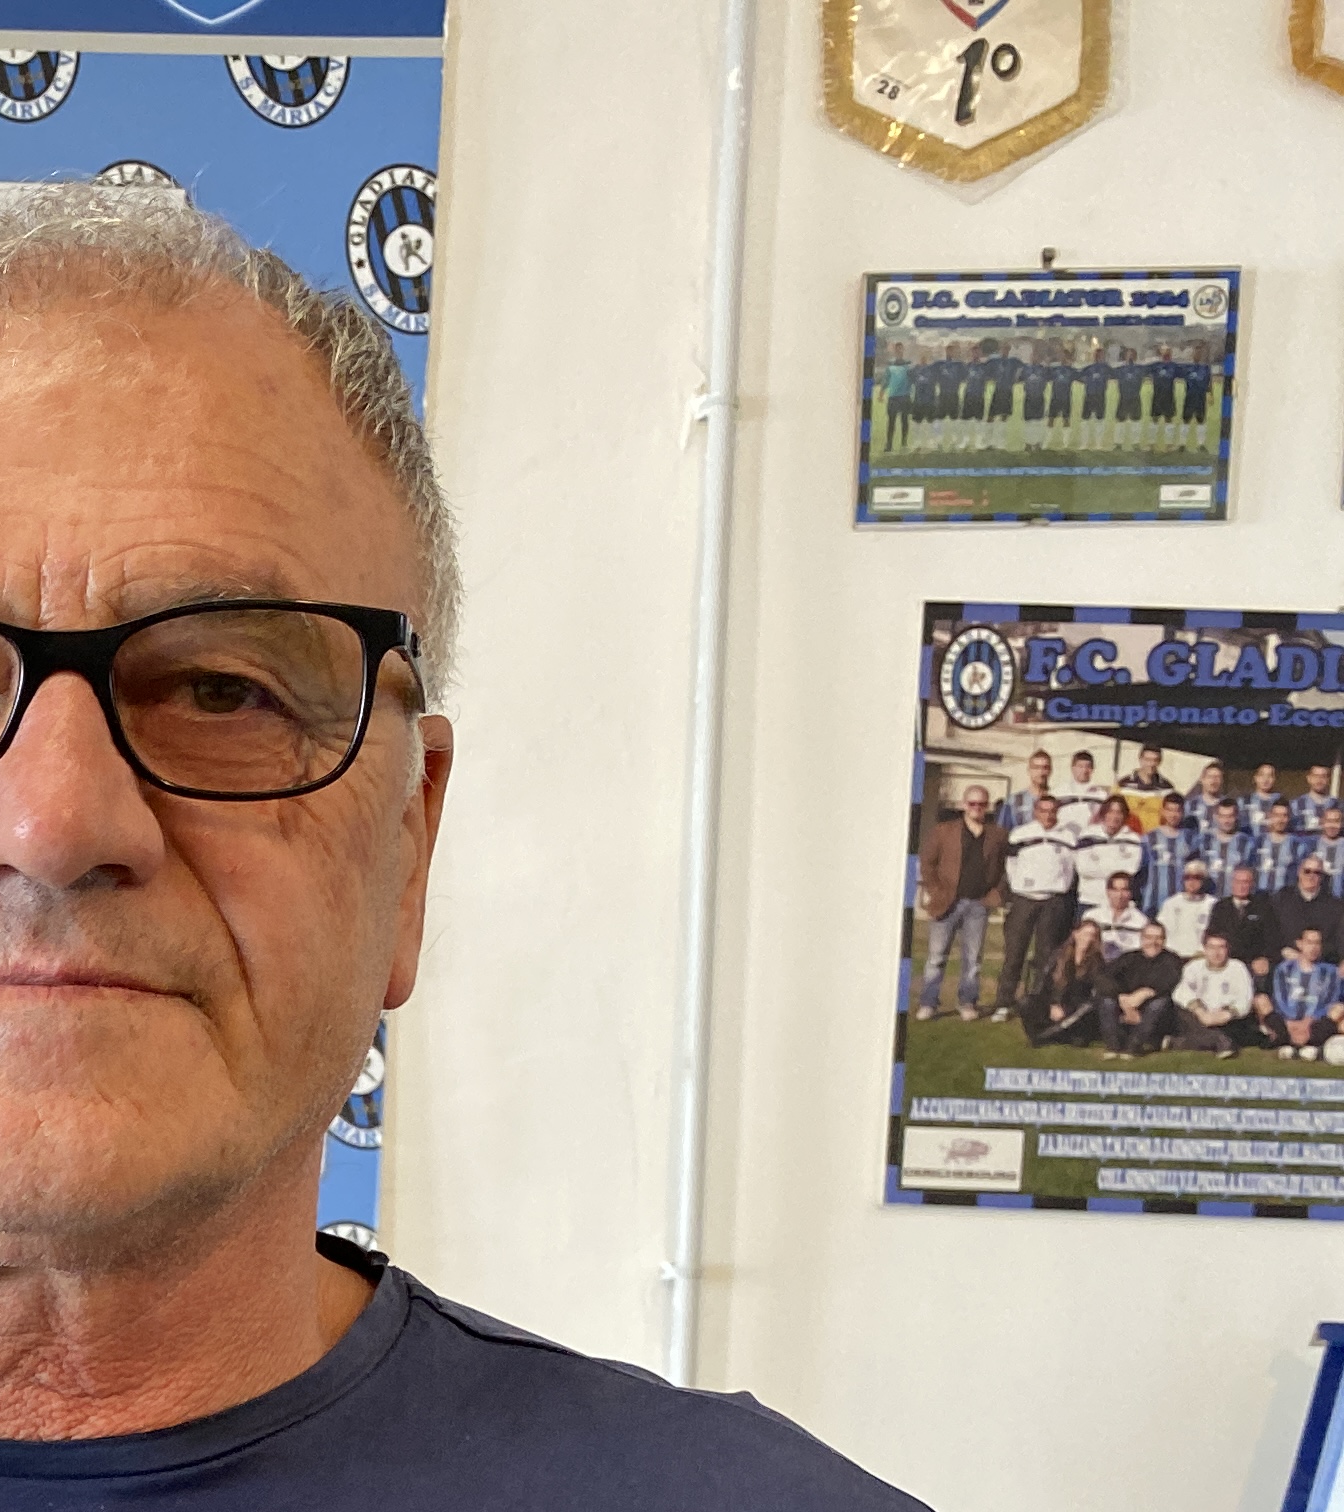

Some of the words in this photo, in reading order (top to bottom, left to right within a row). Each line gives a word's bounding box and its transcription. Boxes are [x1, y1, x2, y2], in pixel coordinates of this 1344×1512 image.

[1024, 637, 1131, 685] F.C.
[1147, 641, 1344, 692] GLADI
[1044, 696, 1259, 727] Campionato
